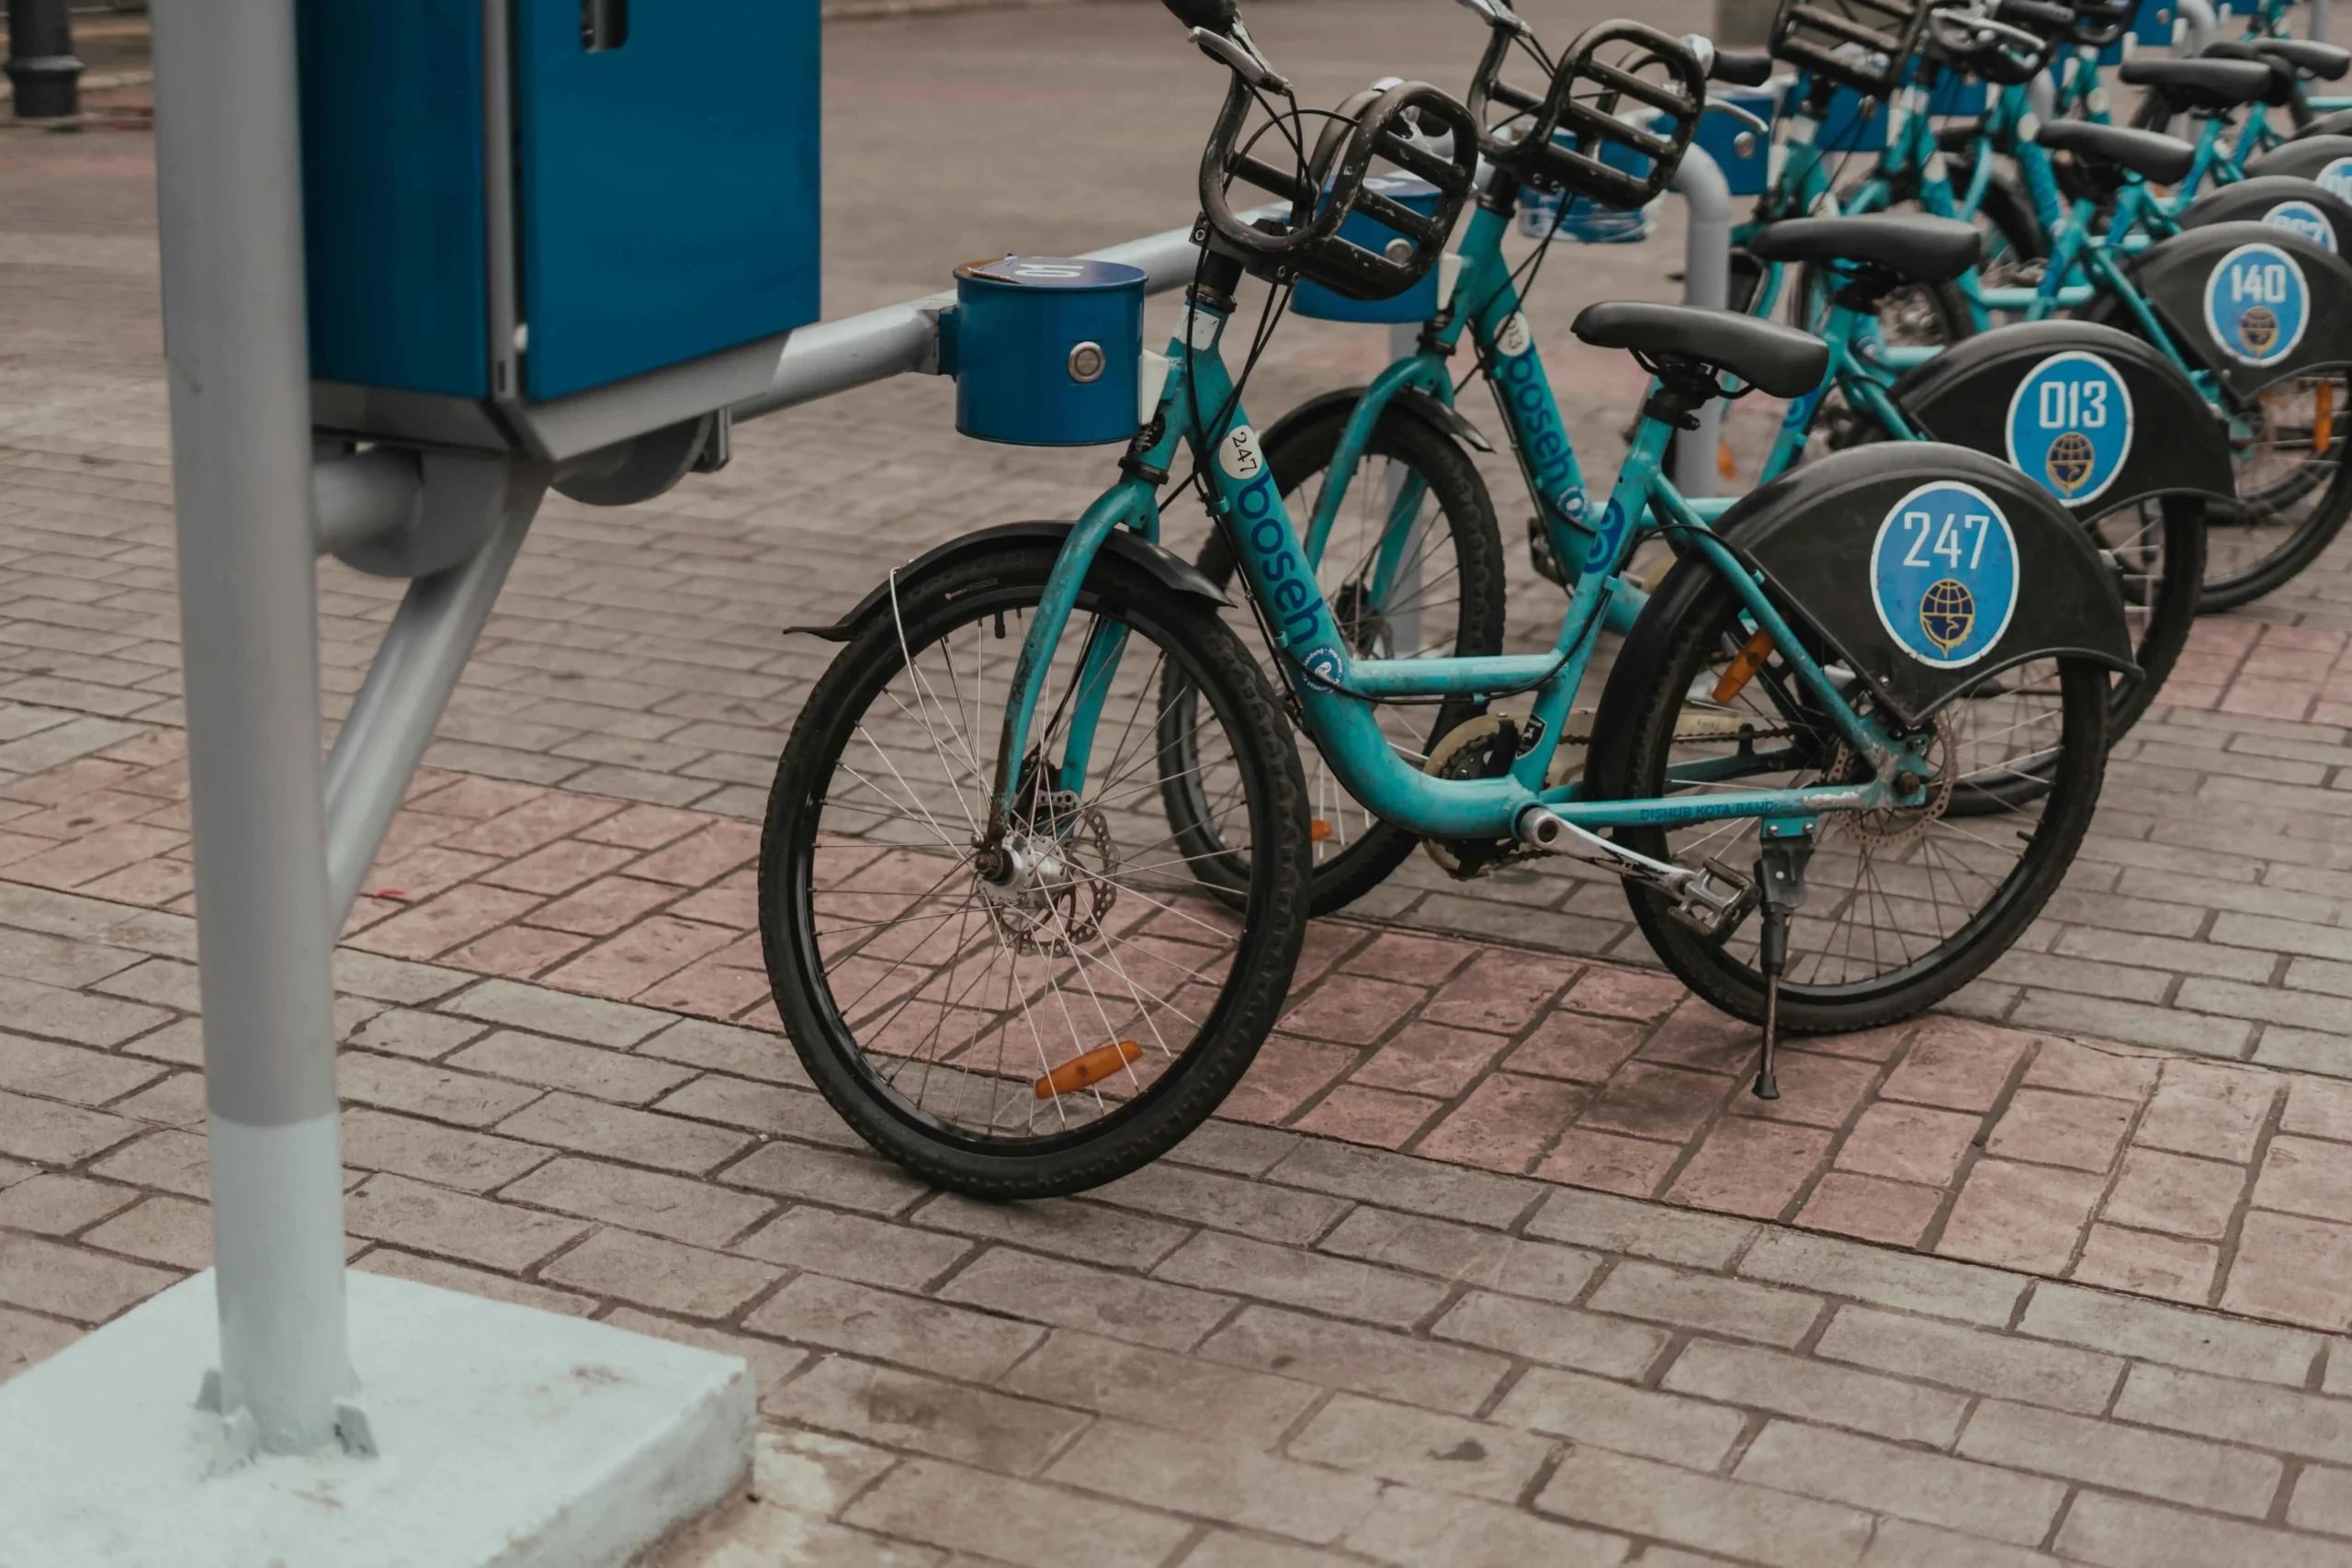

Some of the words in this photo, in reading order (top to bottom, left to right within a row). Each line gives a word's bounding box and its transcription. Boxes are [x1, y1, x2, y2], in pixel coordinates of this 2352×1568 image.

[2231, 263, 2287, 304] 140
[1508, 343, 1572, 489] boseh
[2039, 380, 2108, 429] 013
[1232, 431, 1258, 472] 247
[1237, 468, 1324, 646] boseh
[1903, 511, 1990, 570] 247
[1640, 806, 1692, 820] DISHUB
[1696, 804, 1732, 817] KOTA
